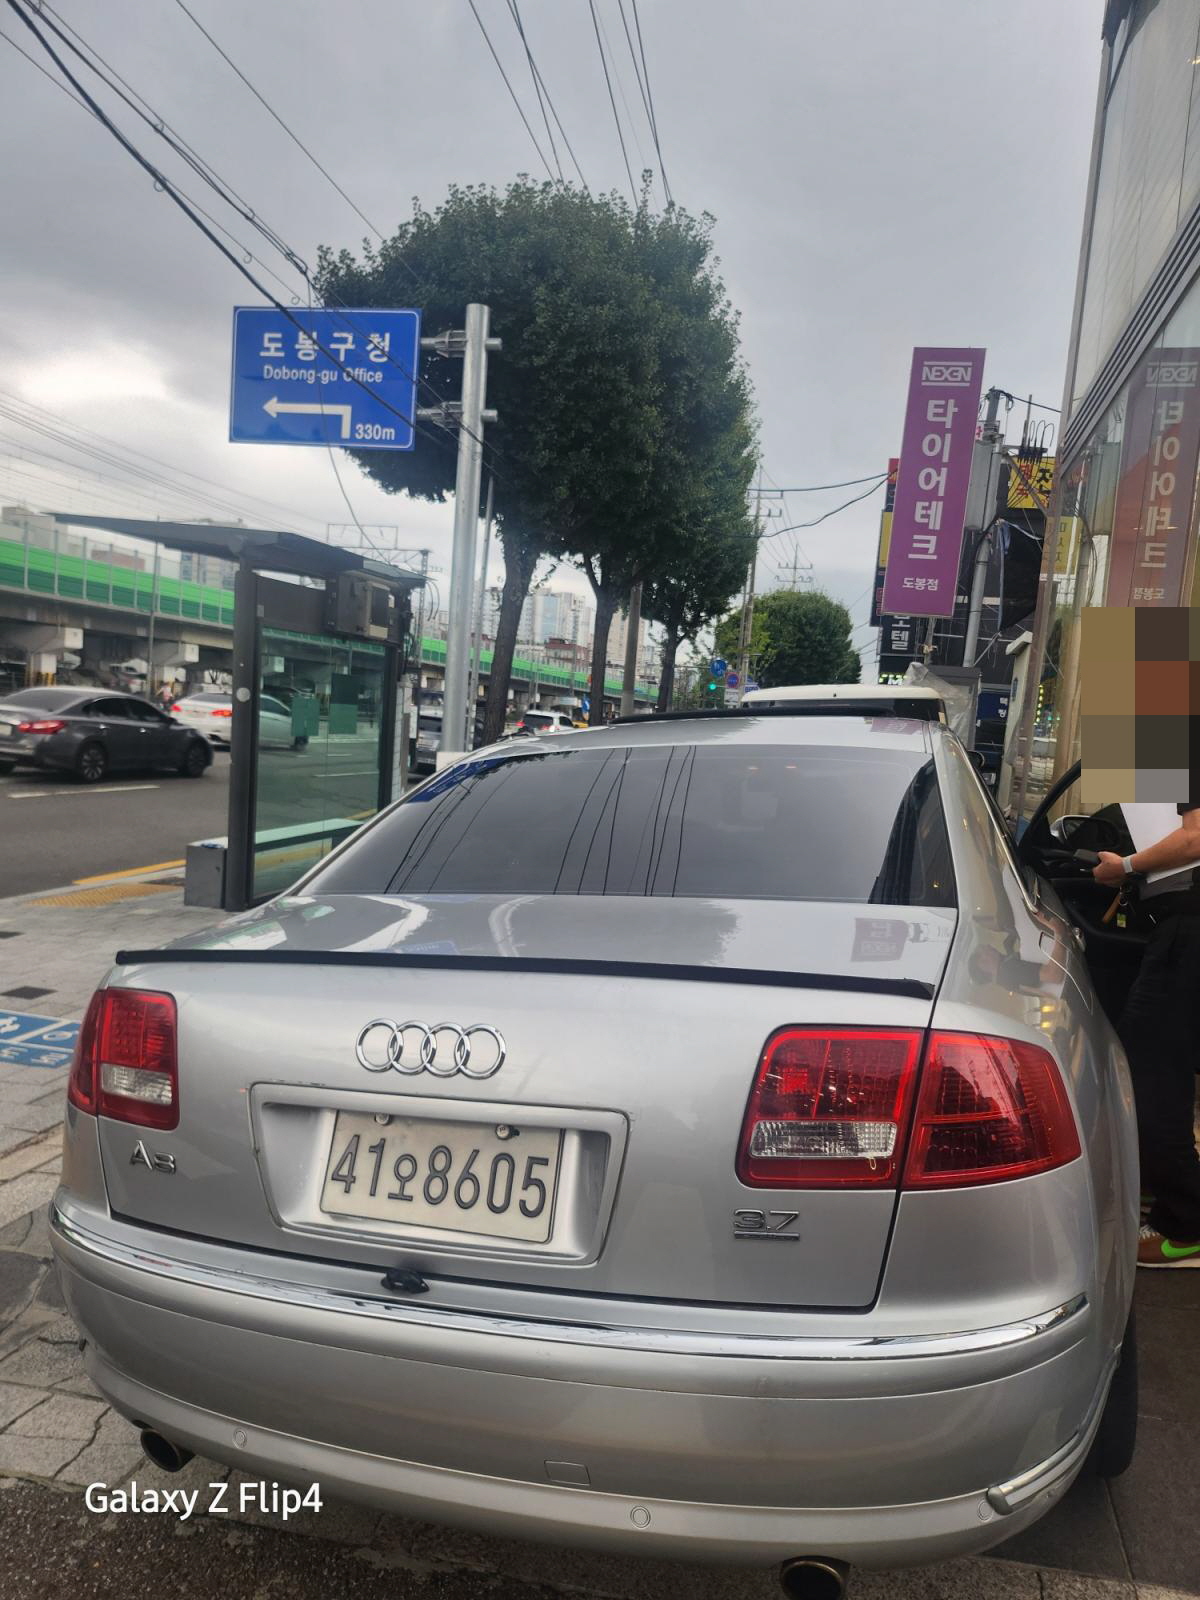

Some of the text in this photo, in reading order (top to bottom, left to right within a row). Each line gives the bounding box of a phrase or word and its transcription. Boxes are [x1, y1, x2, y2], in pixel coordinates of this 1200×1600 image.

[259, 331, 391, 363] 도봉구청
[263, 364, 384, 384] Dobong-gu Office
[921, 366, 973, 382] NEXEN
[355, 423, 395, 441] 330m
[908, 399, 959, 560] 타이어테크
[902, 577, 939, 591] 도봉점
[129, 1139, 177, 1173] A8
[331, 1134, 550, 1218] 41오8605
